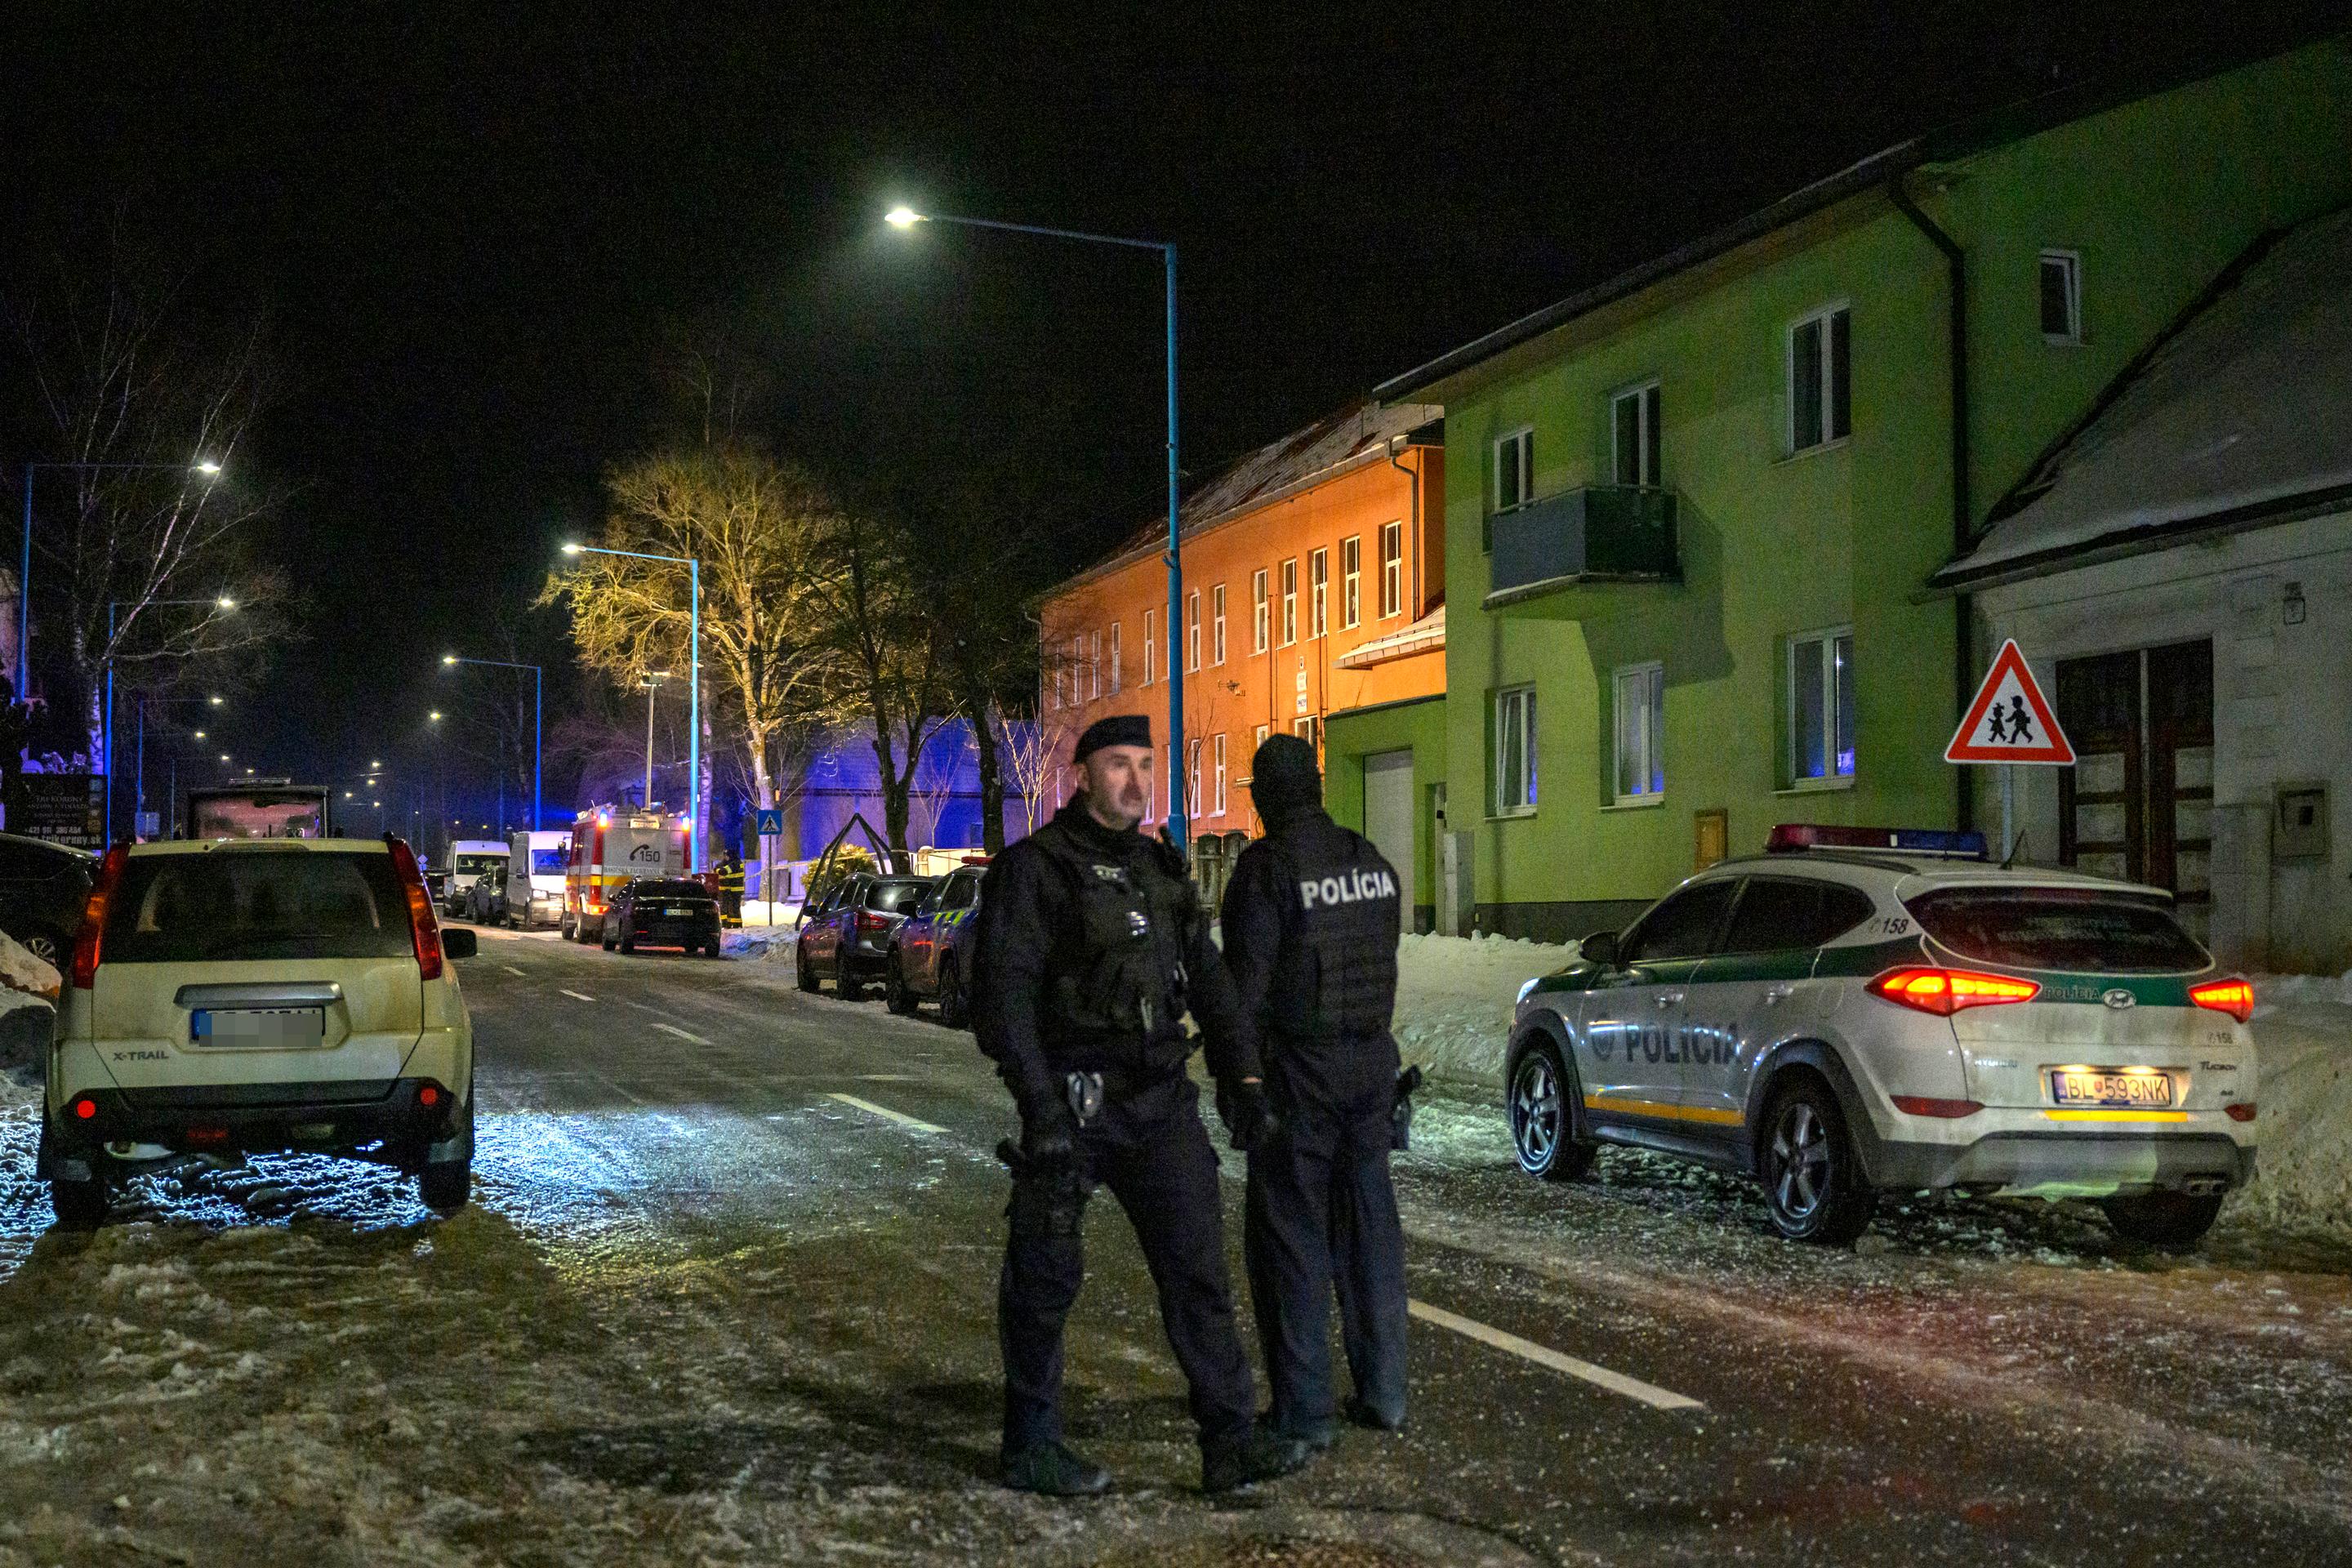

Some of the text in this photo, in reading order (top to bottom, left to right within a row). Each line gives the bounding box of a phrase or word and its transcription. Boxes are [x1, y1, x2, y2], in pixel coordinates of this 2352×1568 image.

[639, 850, 661, 862] 150
[1300, 867, 1396, 909] POLÍCIA
[1883, 917, 1909, 934] 158
[2044, 985, 2100, 1000] POLÍCIA
[113, 1051, 170, 1062] X-TRAIL
